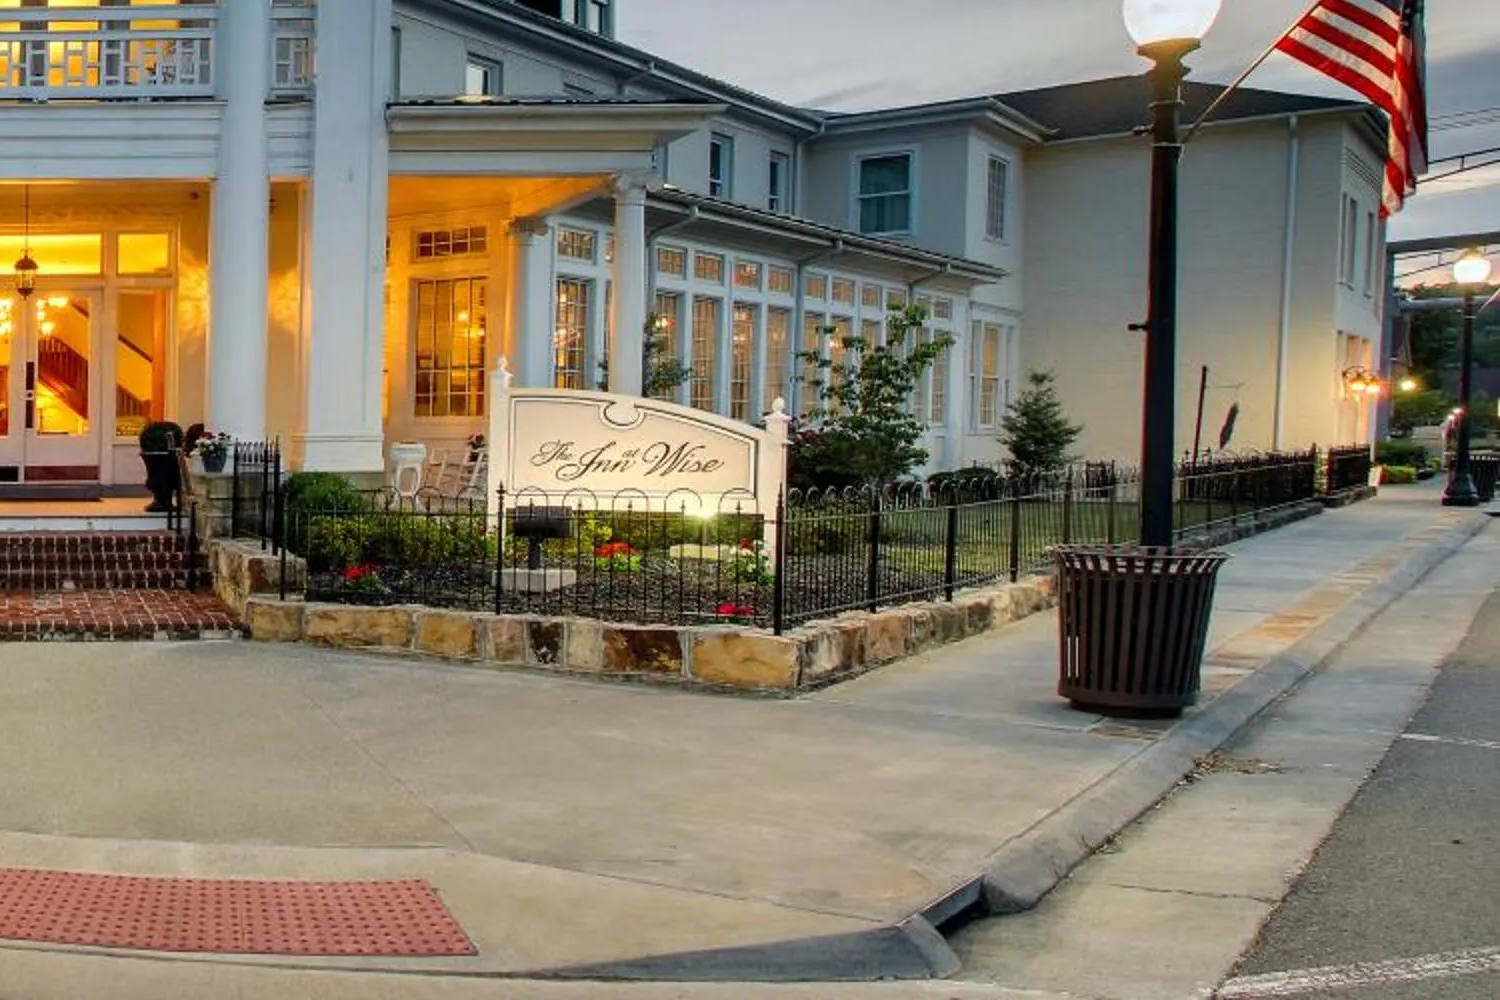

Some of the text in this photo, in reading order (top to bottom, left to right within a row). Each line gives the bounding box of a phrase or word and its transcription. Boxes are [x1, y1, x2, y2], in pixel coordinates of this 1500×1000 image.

[530, 440, 725, 481] The Inn at Wise
